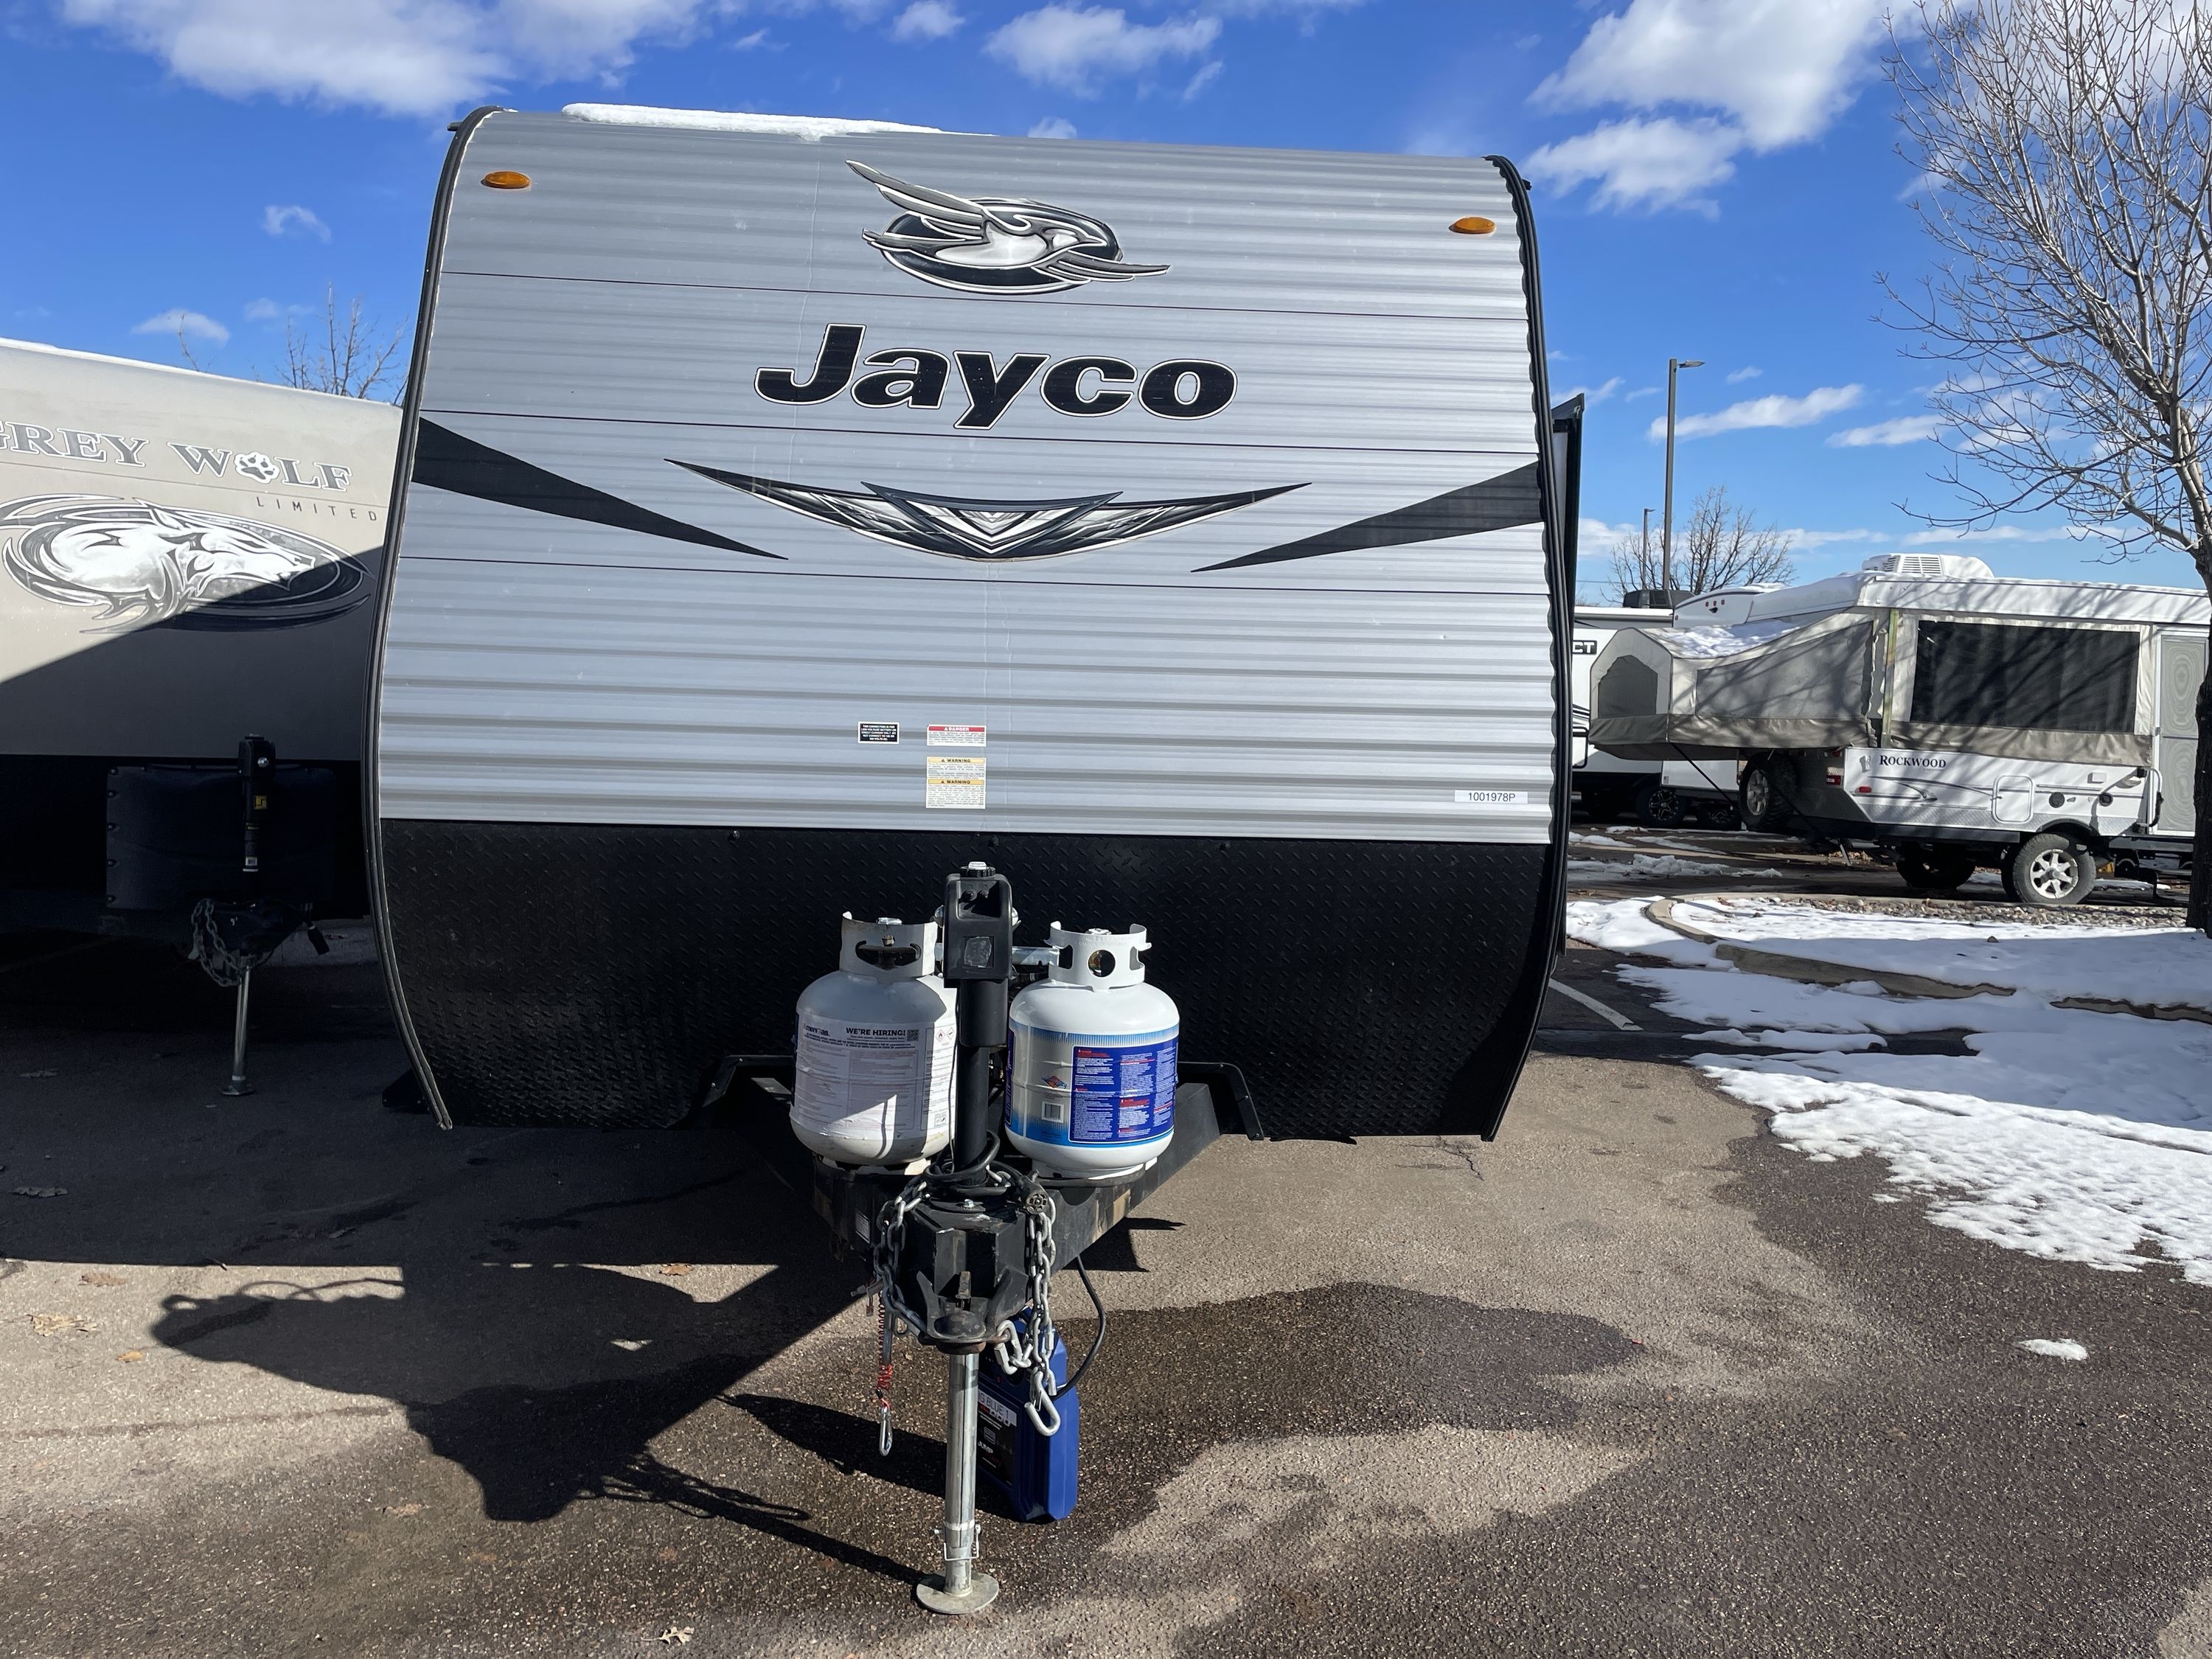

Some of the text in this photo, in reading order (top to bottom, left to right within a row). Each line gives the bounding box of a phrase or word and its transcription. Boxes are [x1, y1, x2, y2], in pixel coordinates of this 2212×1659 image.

[755, 323, 1238, 431] Jayco
[0, 420, 150, 467] REY
[256, 496, 378, 521] LIMITED
[1879, 754, 1947, 768] ROCKWOOD
[1468, 792, 1516, 802] 1001978P
[846, 1027, 906, 1037] WE'RE HIRING!
[986, 1397, 1004, 1416] BLUE
